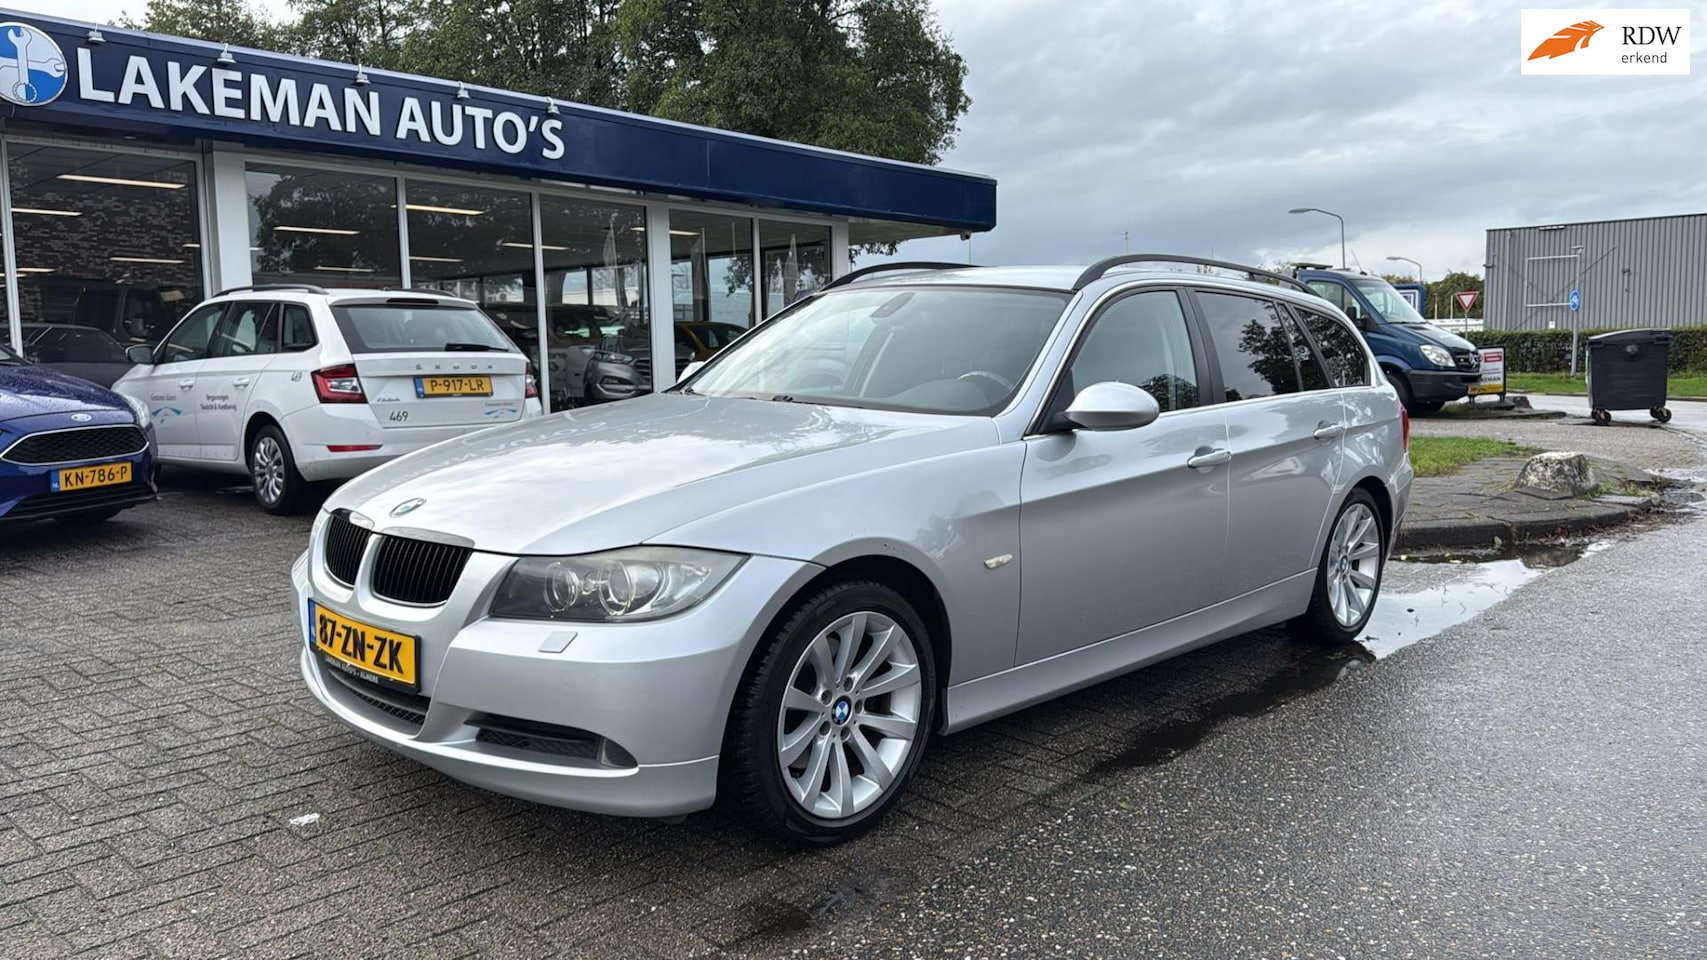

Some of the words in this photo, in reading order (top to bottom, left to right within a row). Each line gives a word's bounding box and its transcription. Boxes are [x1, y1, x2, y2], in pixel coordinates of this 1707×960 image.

[78, 47, 380, 137] LAKEMAN
[397, 96, 566, 160] AUTO'S
[430, 379, 485, 392] P-917-LR
[389, 411, 409, 422] 469
[64, 466, 128, 488] KN-786-P
[319, 613, 404, 675] 87-ZN-ZK
